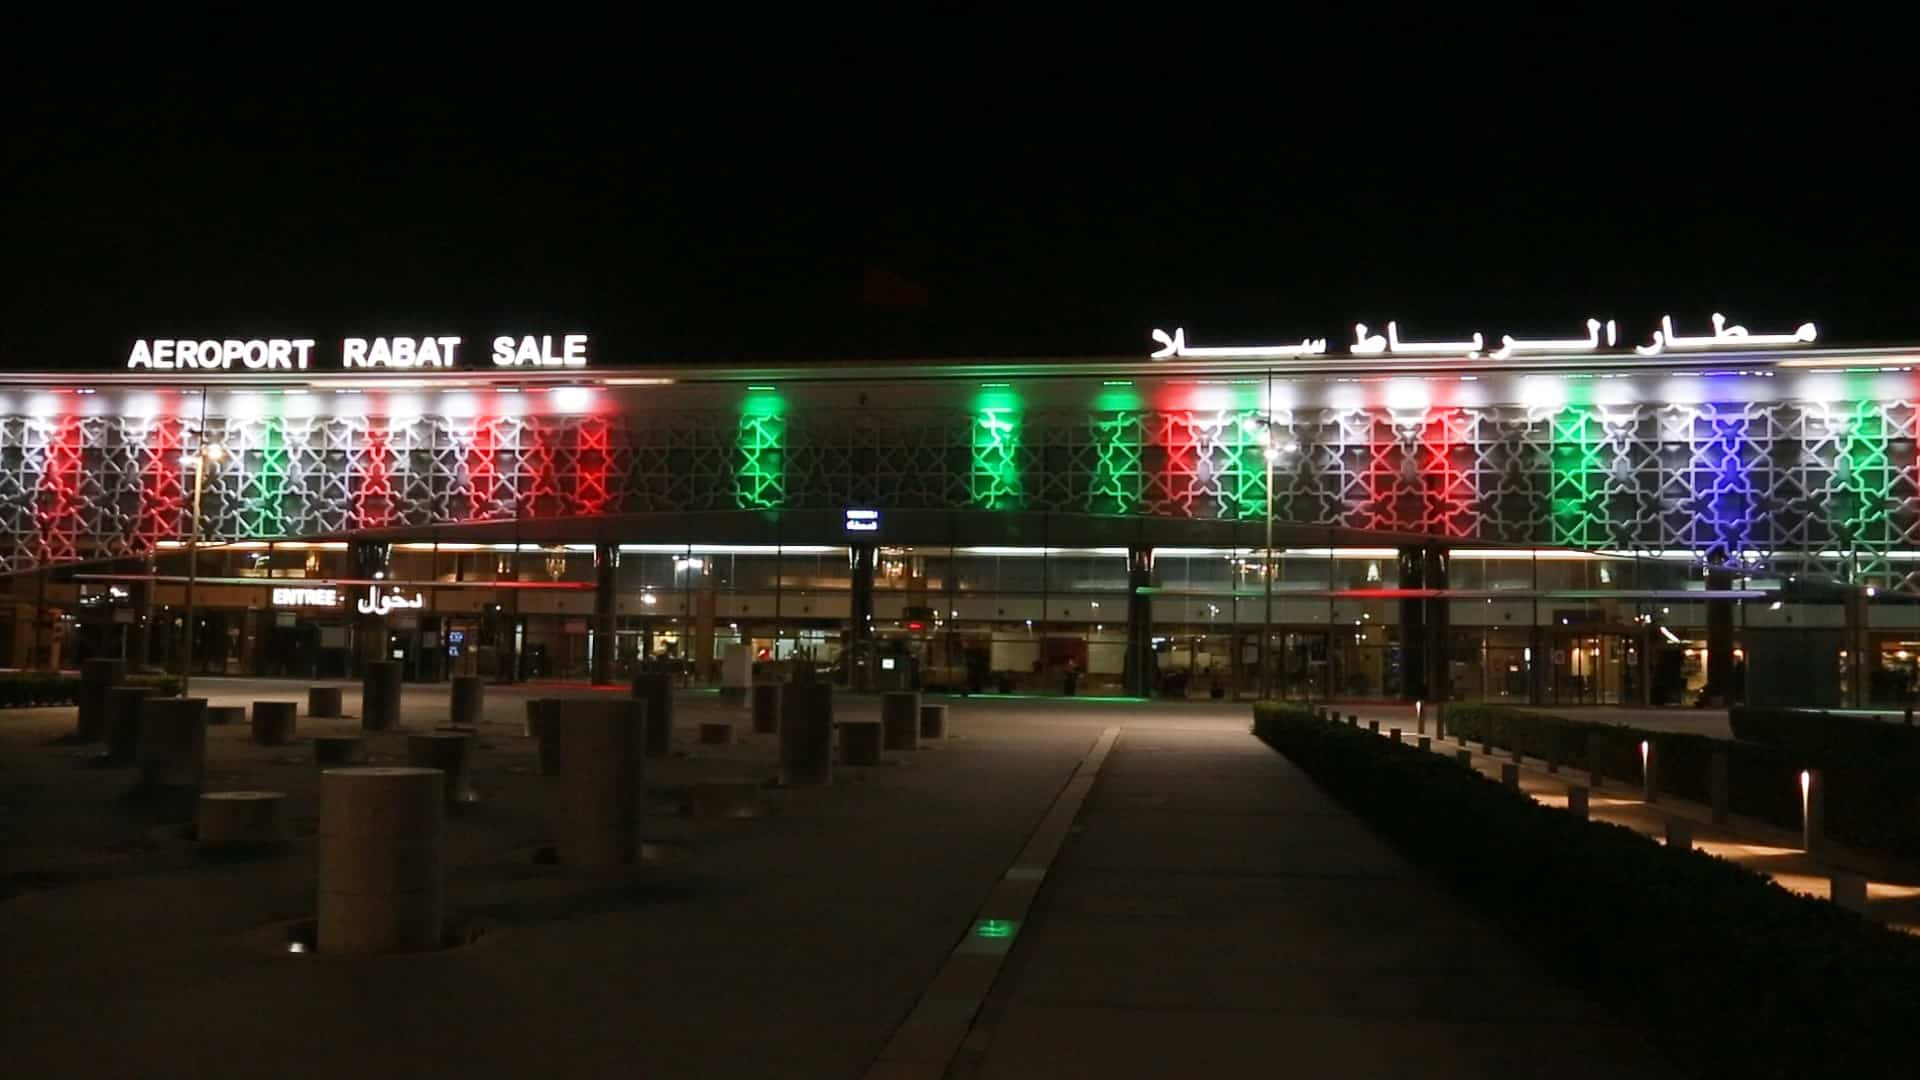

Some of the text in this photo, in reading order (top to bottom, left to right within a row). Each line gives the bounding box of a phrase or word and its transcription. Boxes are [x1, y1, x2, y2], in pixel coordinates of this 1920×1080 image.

[128, 334, 588, 369] AEROPORT RABAT SALE
[1151, 313, 1817, 360] مطار الرباط سلا
[273, 588, 337, 606] ENTREE
[358, 585, 424, 615] دخول
